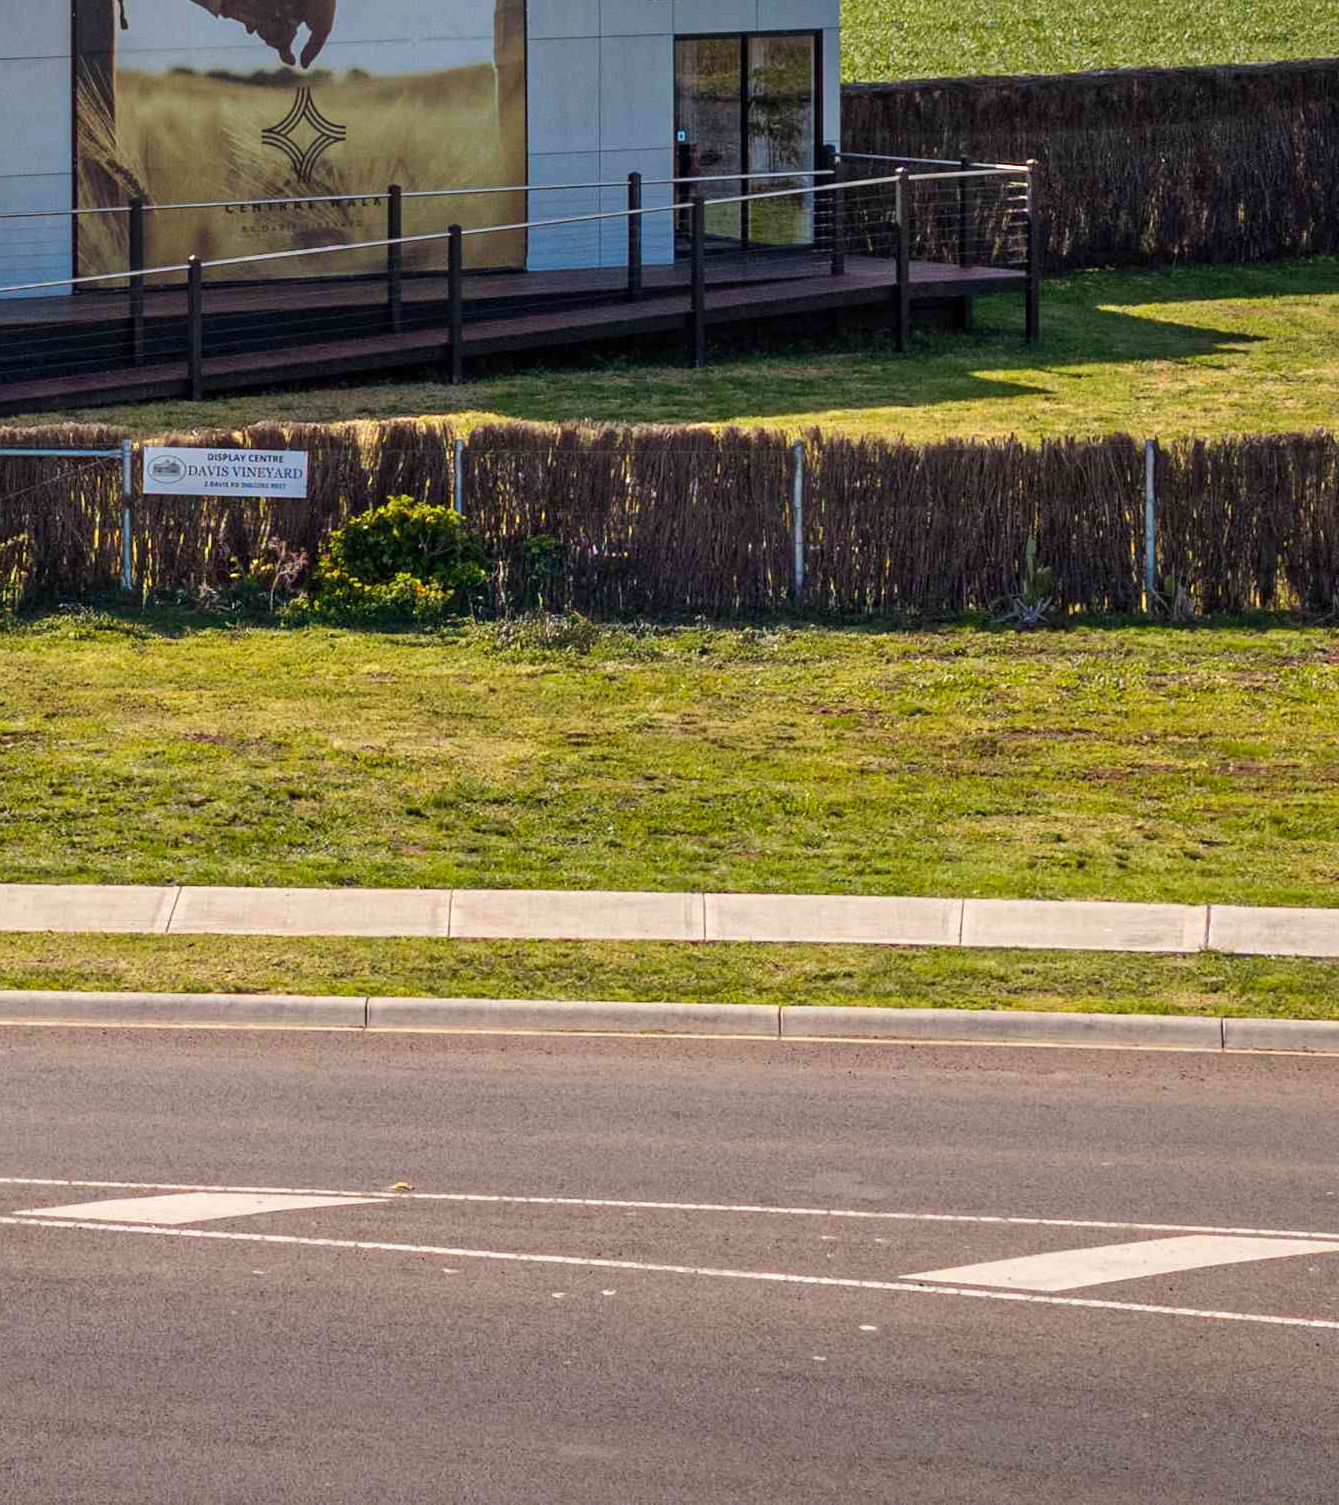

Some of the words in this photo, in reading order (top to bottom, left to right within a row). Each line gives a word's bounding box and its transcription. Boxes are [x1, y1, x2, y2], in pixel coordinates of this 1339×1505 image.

[207, 453, 246, 463] DISPLAY
[249, 453, 284, 464] CENTRE
[188, 464, 229, 478] DAVIS
[232, 465, 303, 480] VINEYARD
